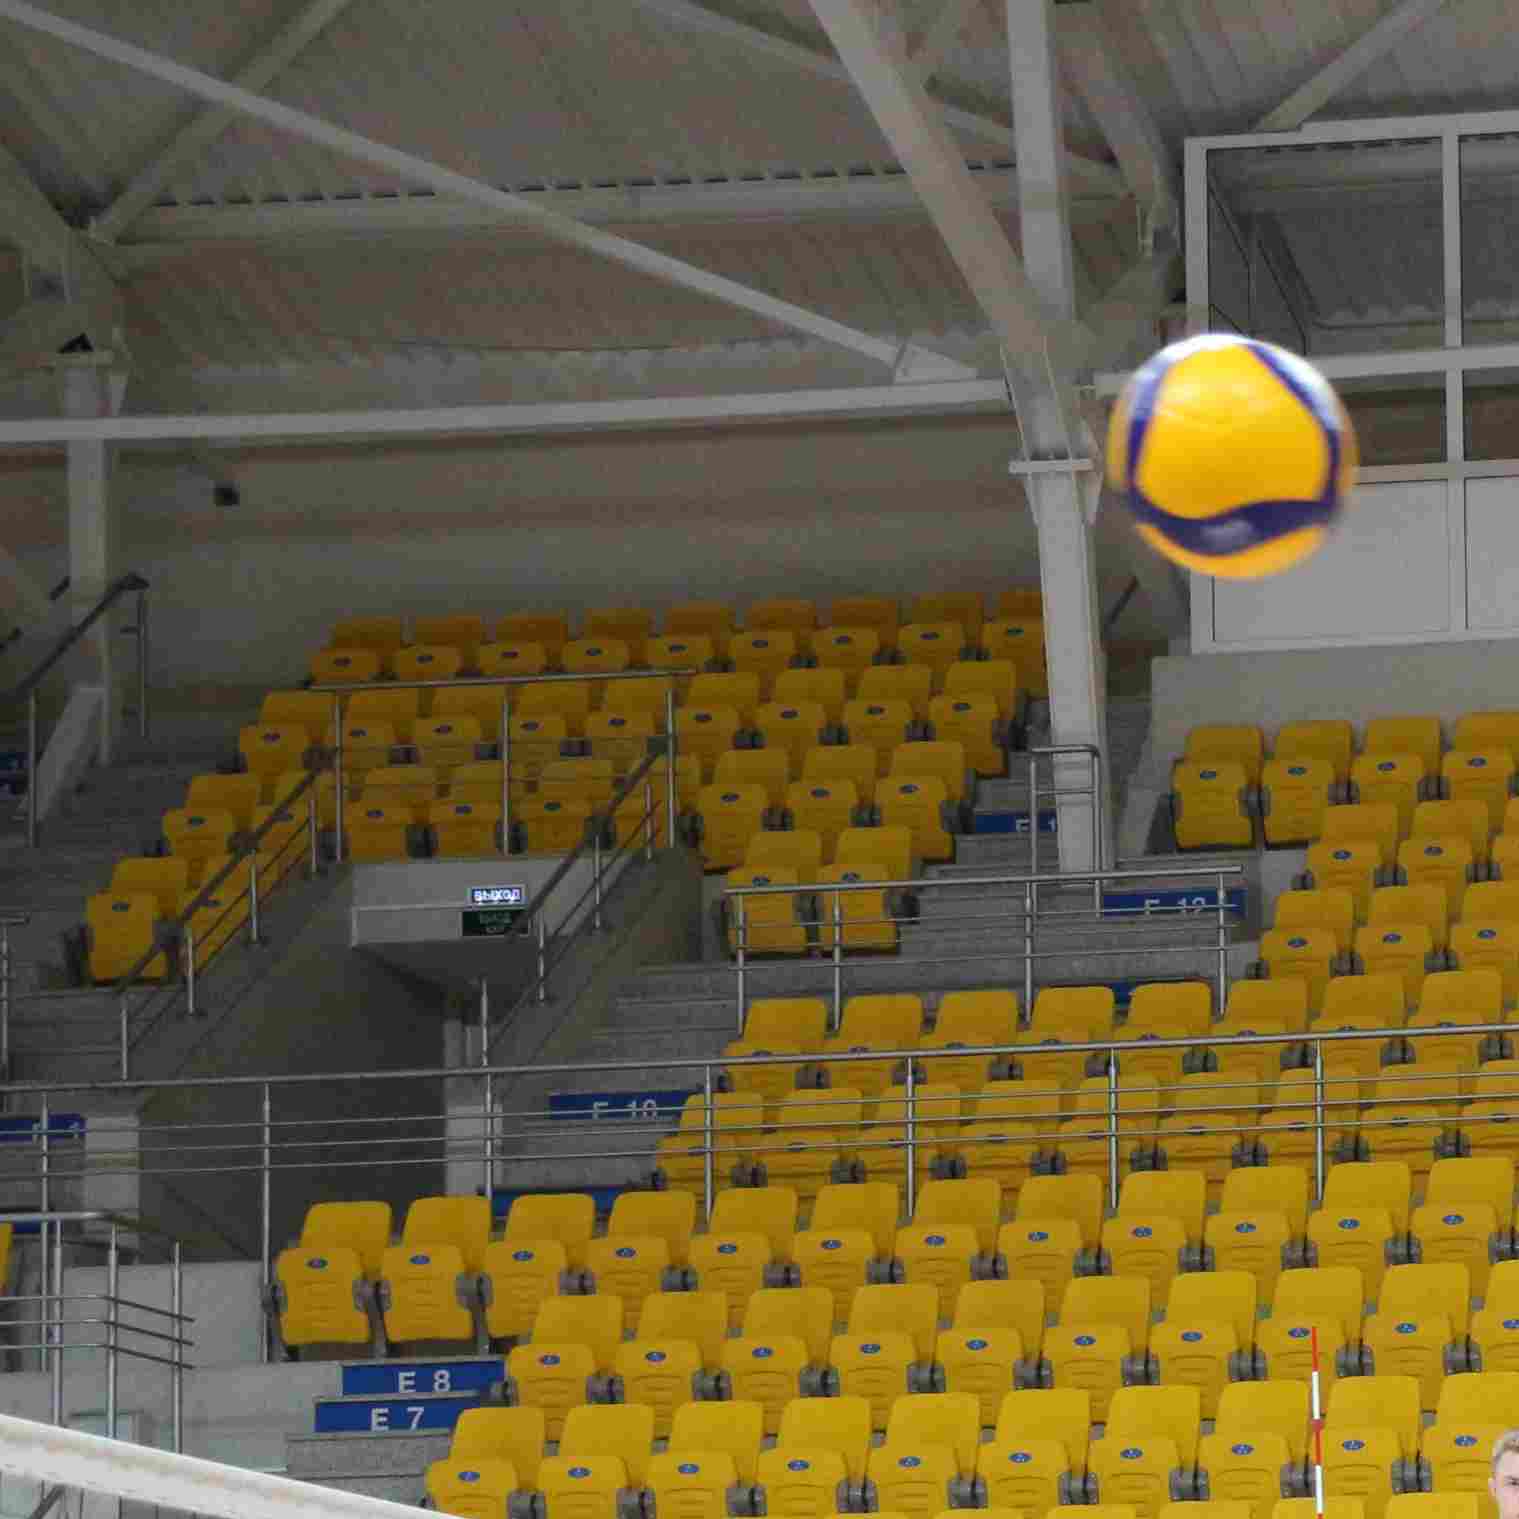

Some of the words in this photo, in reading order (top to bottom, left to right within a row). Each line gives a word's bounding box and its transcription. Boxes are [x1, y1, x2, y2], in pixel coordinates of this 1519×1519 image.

[473, 888, 521, 902] ВЫХОД
[398, 1371, 416, 1392] E
[433, 1369, 451, 1392] 8
[371, 1408, 389, 1432] E
[407, 1407, 425, 1431] 7
